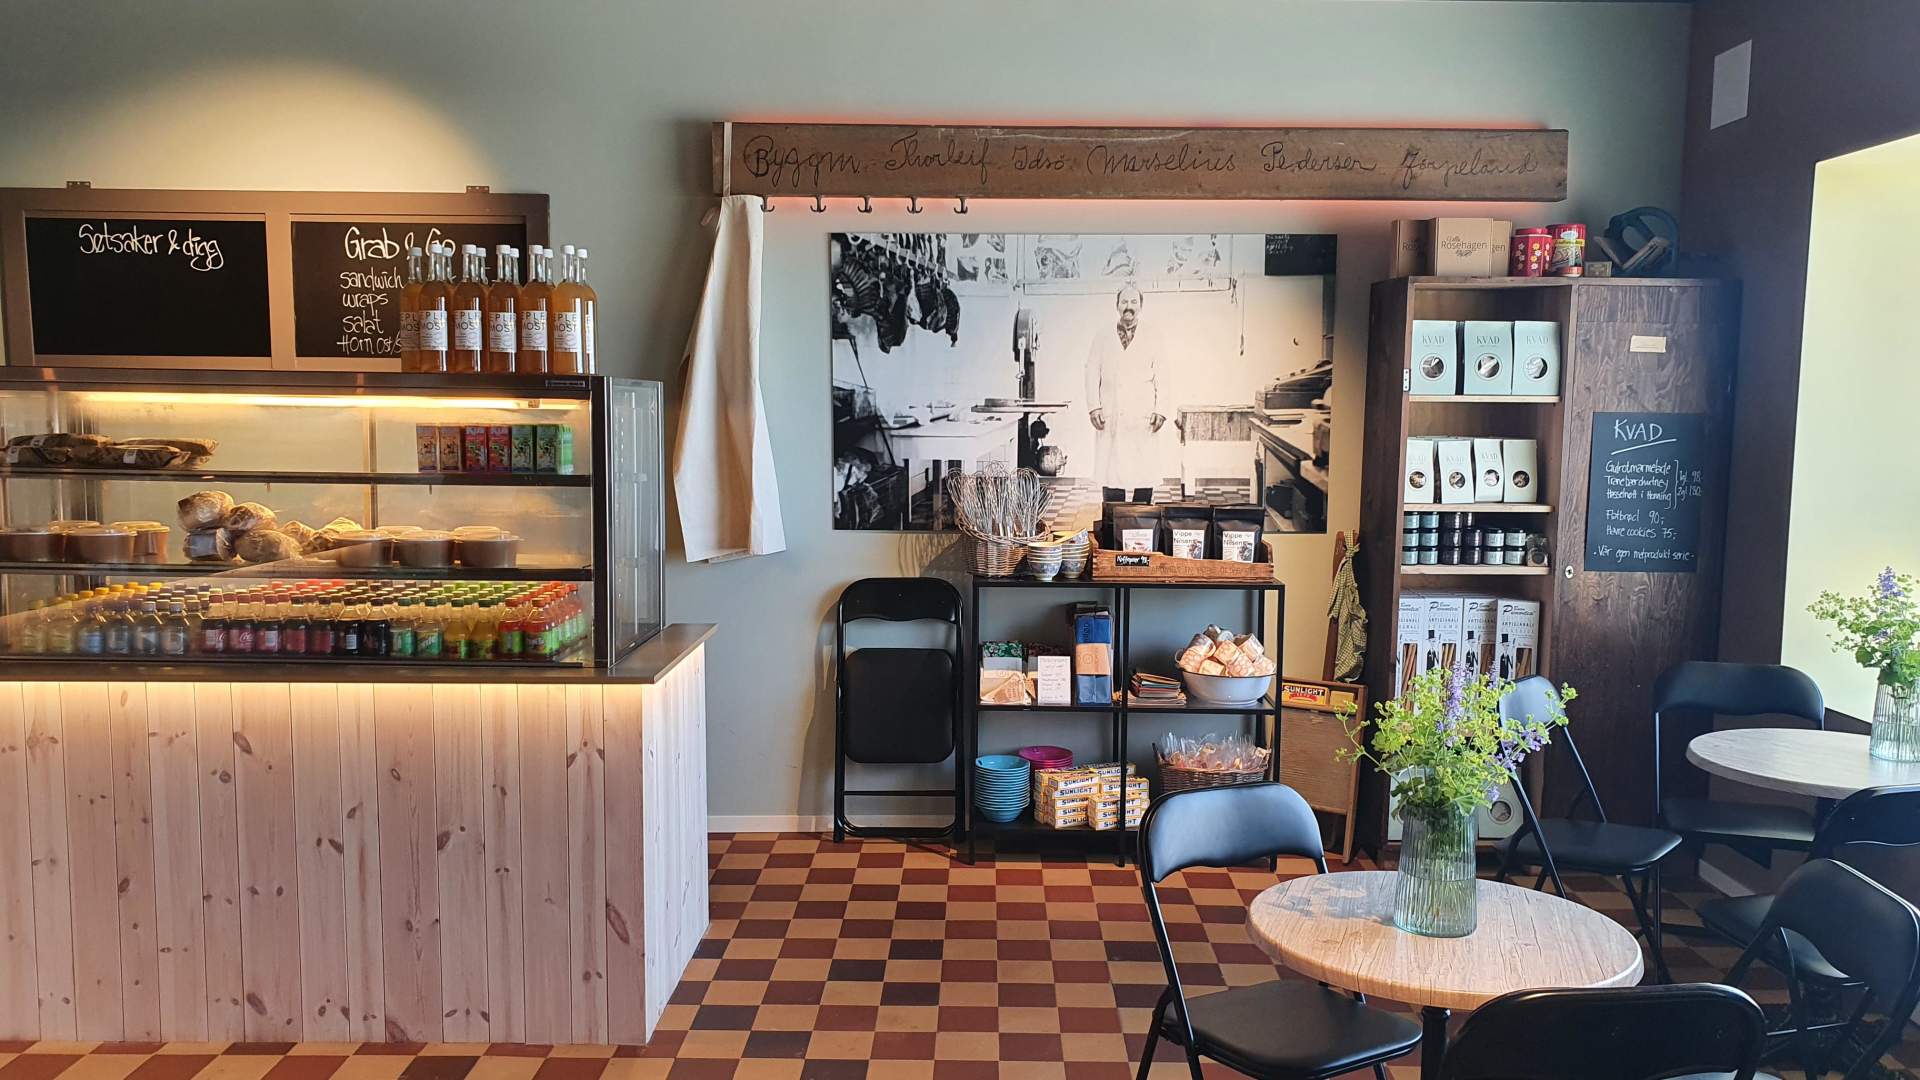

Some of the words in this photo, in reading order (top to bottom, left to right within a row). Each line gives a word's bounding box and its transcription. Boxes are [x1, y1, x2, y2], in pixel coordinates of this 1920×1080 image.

[1087, 144, 1237, 175] Marselius
[1261, 141, 1376, 173] Pedersen
[79, 221, 163, 254] Søtsaker
[168, 229, 181, 255] &
[182, 227, 225, 272] digg
[344, 226, 400, 261] Grab
[1441, 240, 1487, 254] Rosehagen
[340, 267, 404, 291] sandwich
[342, 293, 389, 316] wraps
[343, 309, 384, 335] salat
[1422, 335, 1445, 345] KVAD
[1476, 335, 1500, 345] KVAD
[1526, 335, 1549, 345] KVAD
[1614, 419, 1663, 442] KVAD
[1283, 685, 1324, 697] SUNLIGHT
[1064, 777, 1093, 787] SUNLIGHT
[1060, 788, 1092, 796] SUNLIGHT
